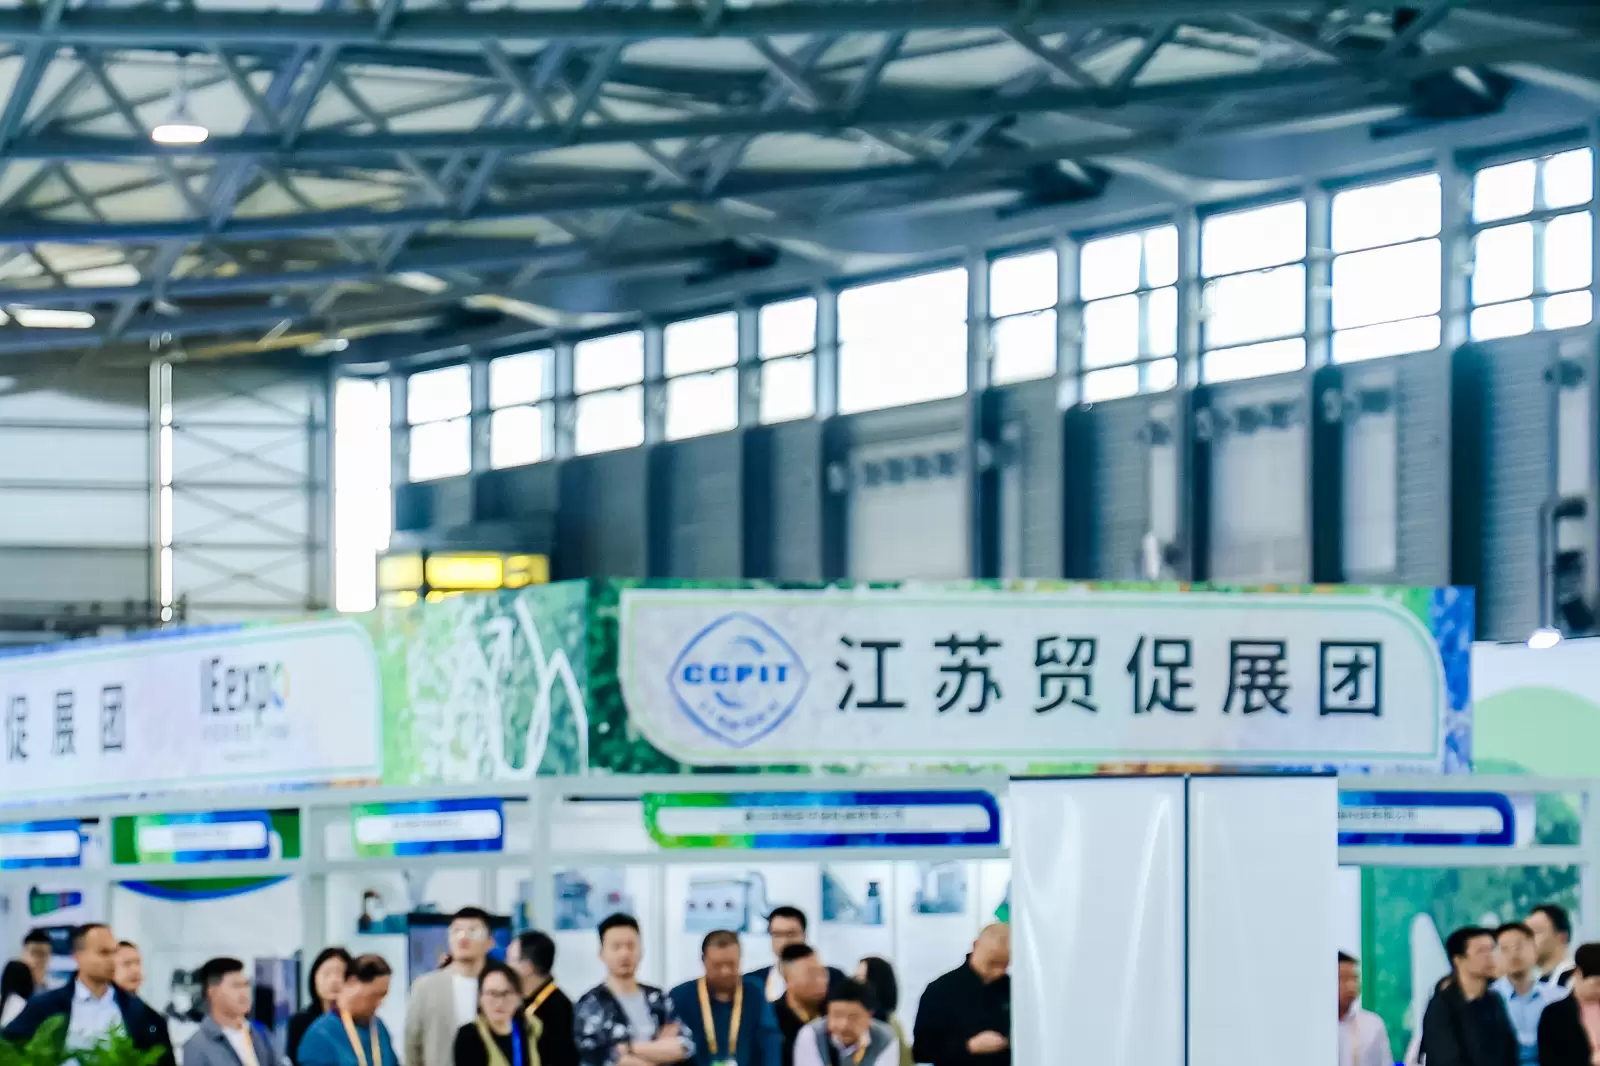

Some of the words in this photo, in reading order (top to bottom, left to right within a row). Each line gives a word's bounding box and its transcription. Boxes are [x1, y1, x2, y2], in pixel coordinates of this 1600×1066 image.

[683, 663, 791, 684] CCPIT
[834, 633, 1384, 718] 江苏贸促展团
